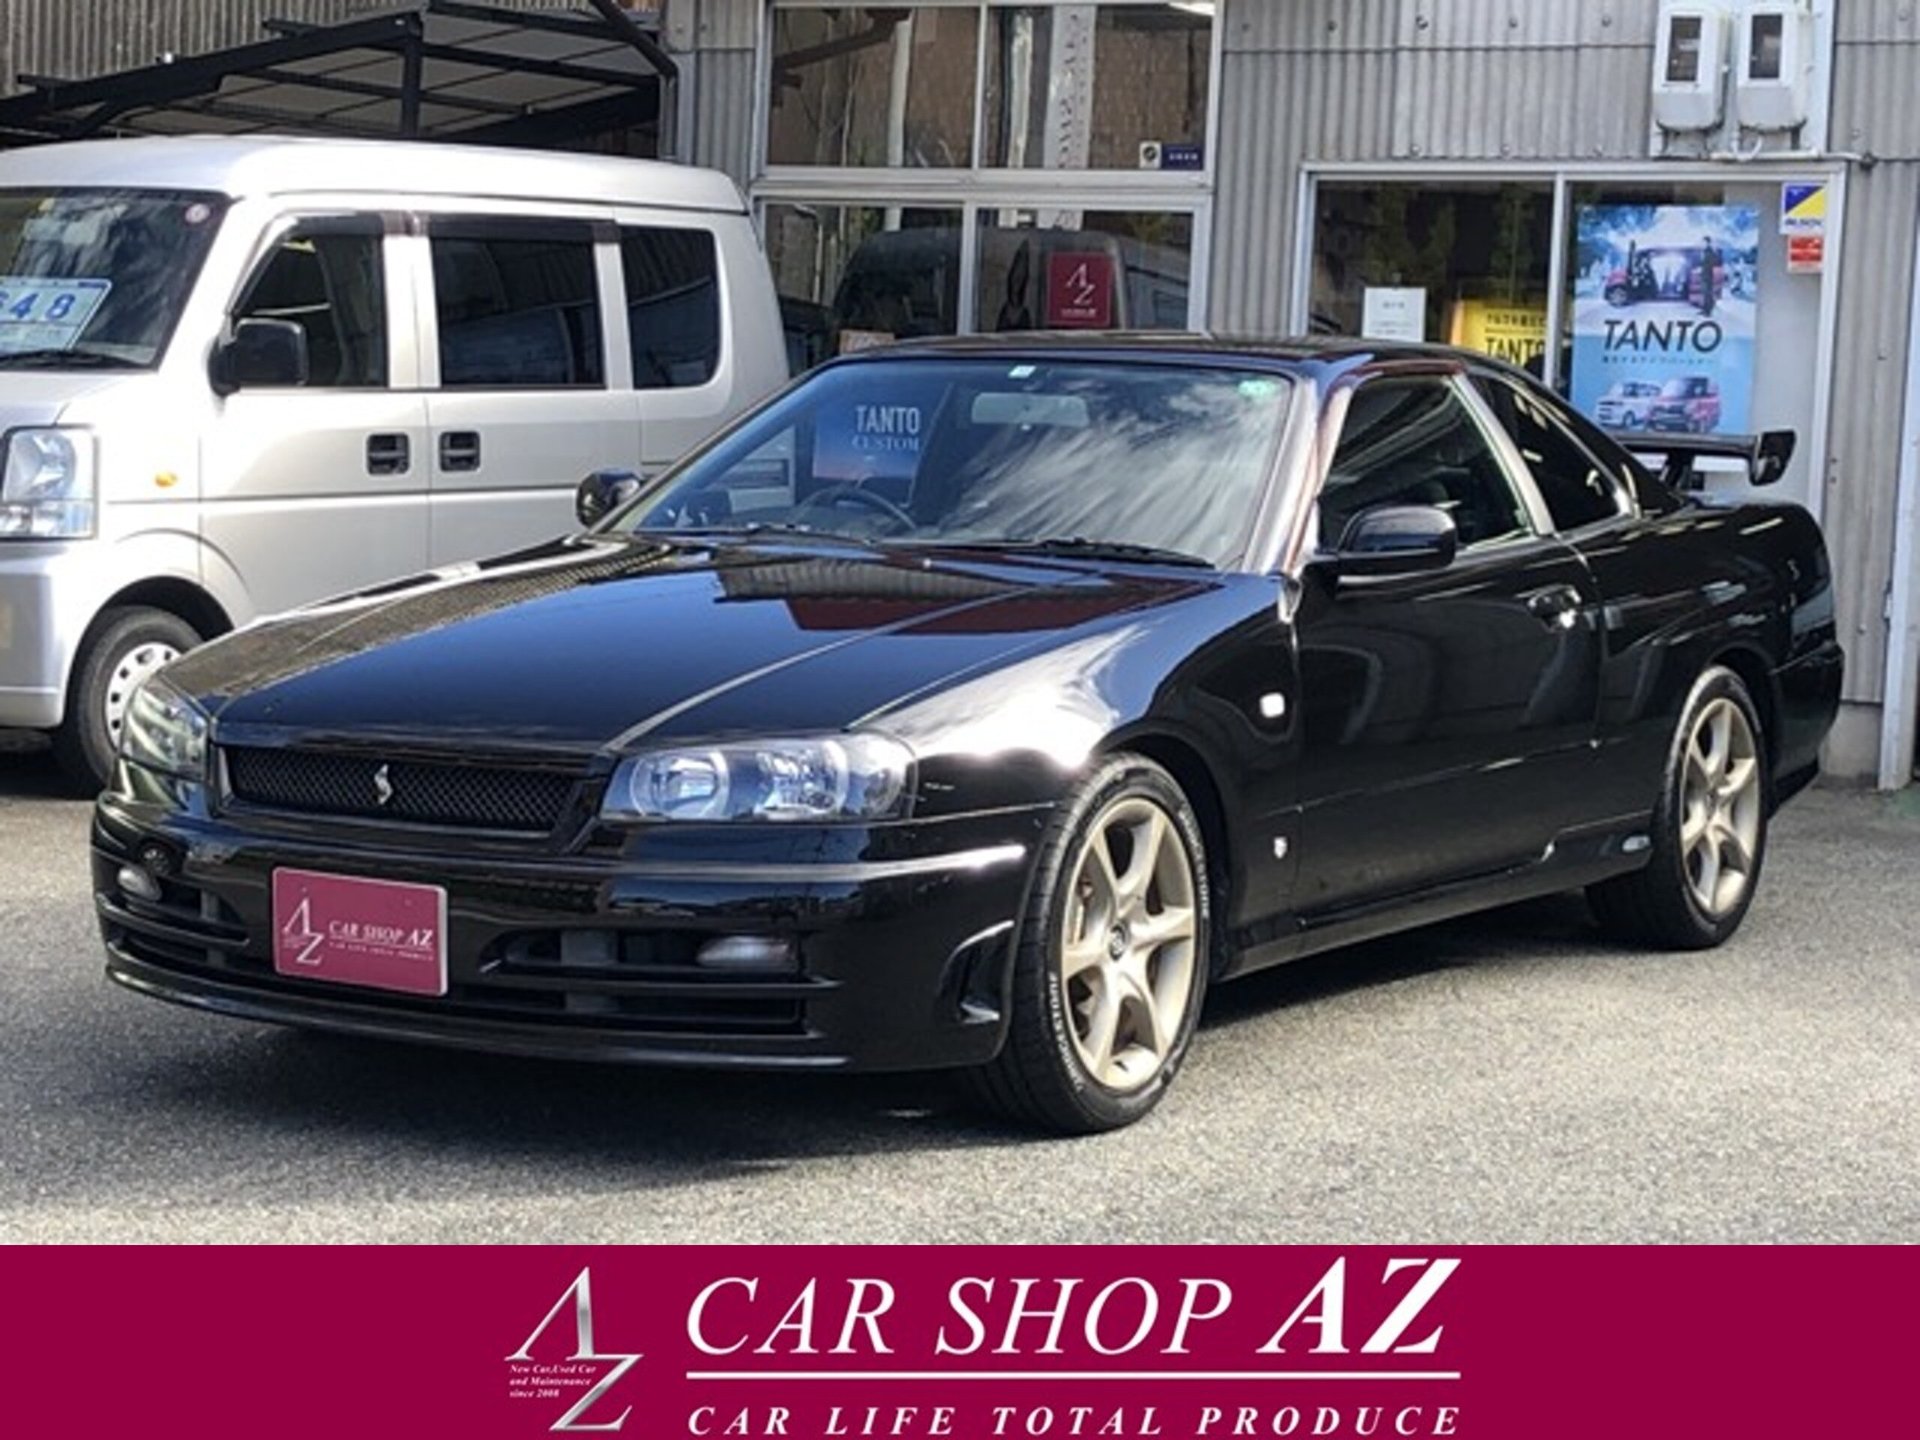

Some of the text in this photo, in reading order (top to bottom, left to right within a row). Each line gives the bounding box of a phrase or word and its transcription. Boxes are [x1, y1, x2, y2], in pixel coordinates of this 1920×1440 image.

[0, 291, 76, 319] 48
[1604, 320, 1723, 352] TANTO
[855, 405, 921, 434] TANTO
[851, 434, 920, 451] CUSTOM
[329, 920, 434, 946] CAR SHOP AZ
